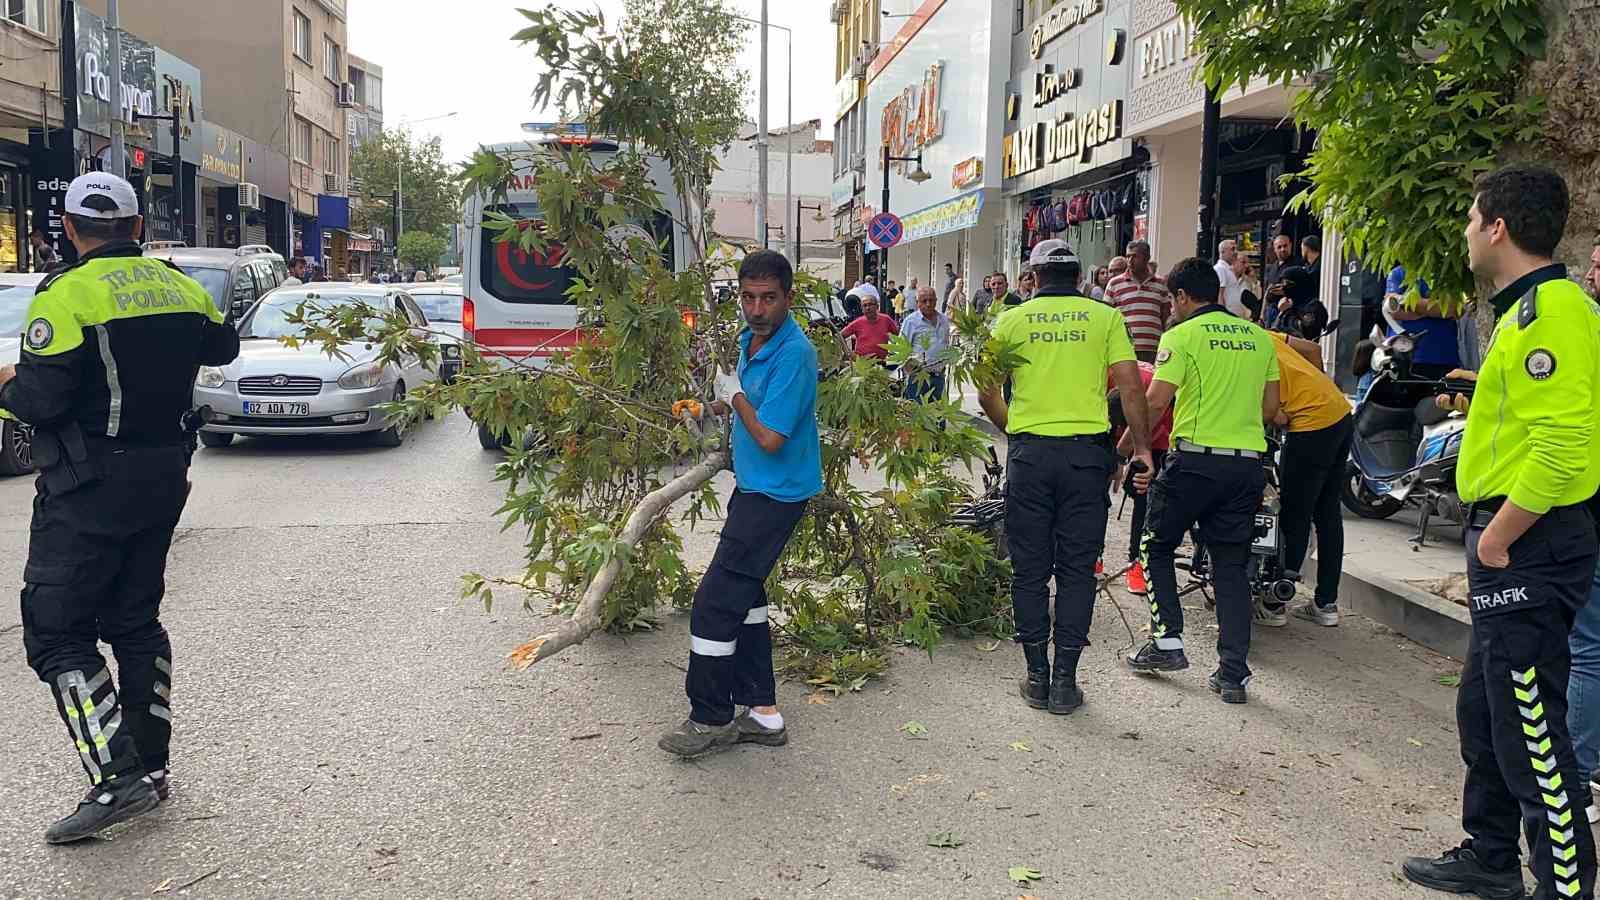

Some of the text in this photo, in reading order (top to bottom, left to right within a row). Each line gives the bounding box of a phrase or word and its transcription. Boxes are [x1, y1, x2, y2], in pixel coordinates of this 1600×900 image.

[250, 403, 307, 414] 02 ADA 778
[1472, 586, 1528, 610] TRAFİK
